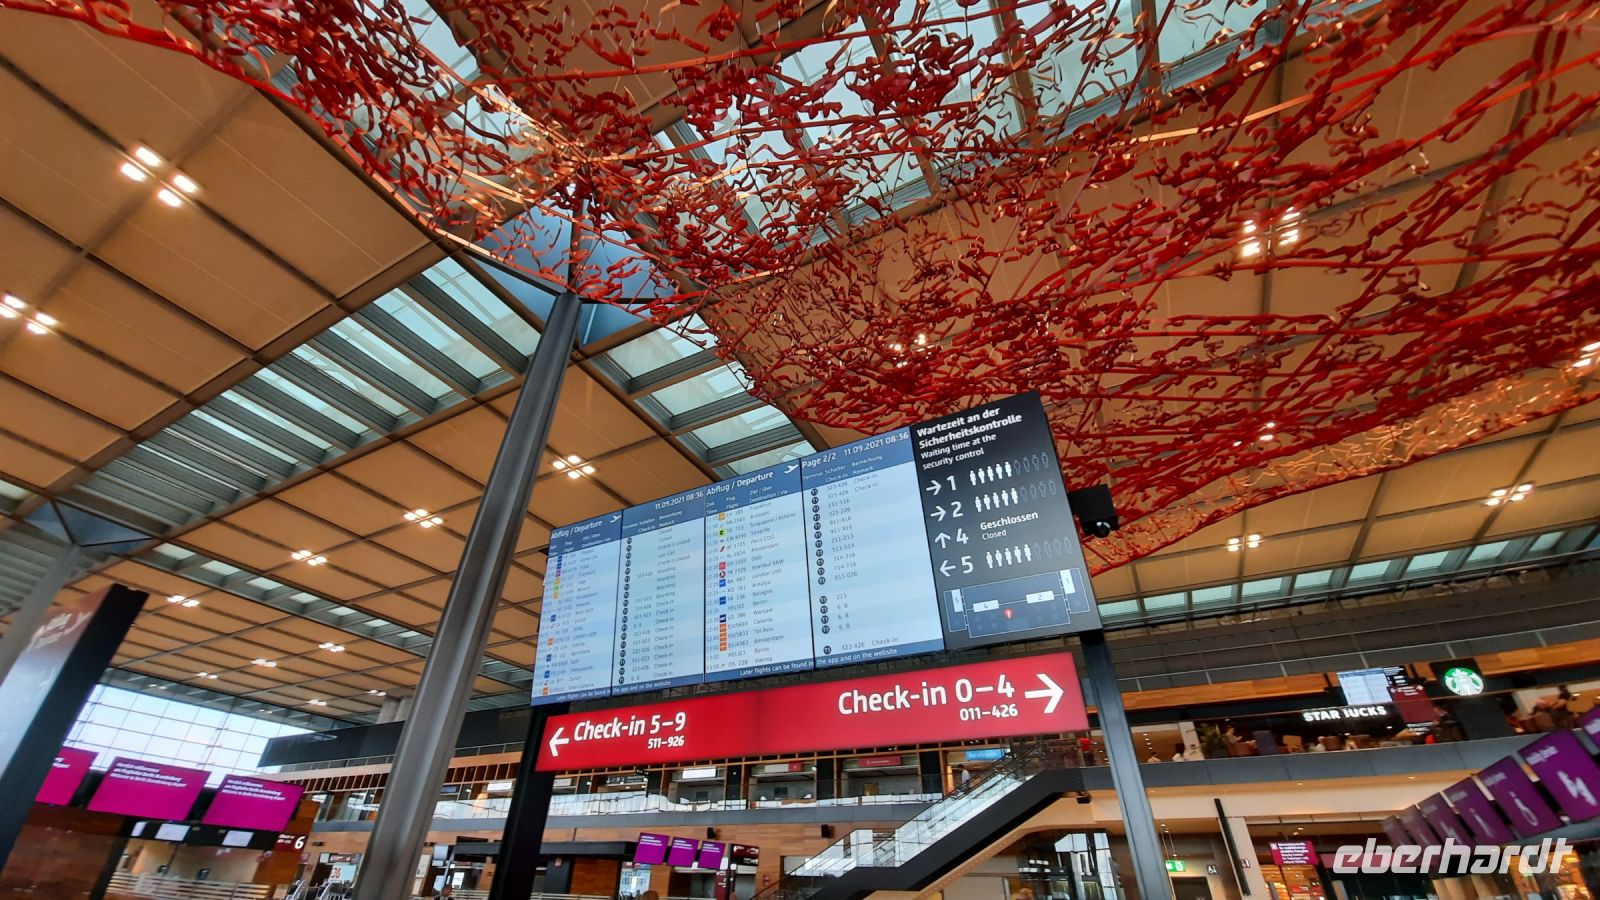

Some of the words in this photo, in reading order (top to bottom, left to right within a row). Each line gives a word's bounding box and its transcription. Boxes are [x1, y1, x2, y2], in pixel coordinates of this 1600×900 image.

[917, 417, 965, 437] Wartezeit
[968, 413, 980, 422] an
[982, 407, 1000, 420] der
[919, 414, 1022, 449] Sicherheitskontrolle
[802, 459, 821, 468] Page
[823, 453, 837, 463] 2/2
[844, 440, 884, 456] 11.09.2021
[886, 432, 909, 444] 08:36
[920, 445, 950, 460] Waiting
[952, 441, 970, 451] time
[972, 438, 980, 446] at
[982, 433, 996, 442] the
[922, 456, 954, 470] security
[955, 448, 984, 462] control
[706, 484, 730, 496] Abflug
[737, 471, 774, 487] Departure
[946, 476, 956, 490] 1
[656, 497, 685, 510] 11.09.2021
[686, 491, 704, 501] 08:36
[951, 501, 964, 518] 2
[574, 520, 602, 534] Departure
[980, 512, 1038, 530] Geschlossen
[956, 528, 969, 544] 4
[982, 529, 1007, 541] Closed
[961, 555, 974, 574] 5
[755, 666, 771, 676] flights
[792, 661, 807, 669] found
[828, 656, 839, 665] app
[840, 654, 852, 662] and
[874, 648, 898, 656] website
[838, 680, 946, 715] Check-in
[574, 715, 646, 742] Check-in
[294, 836, 306, 850] 6
